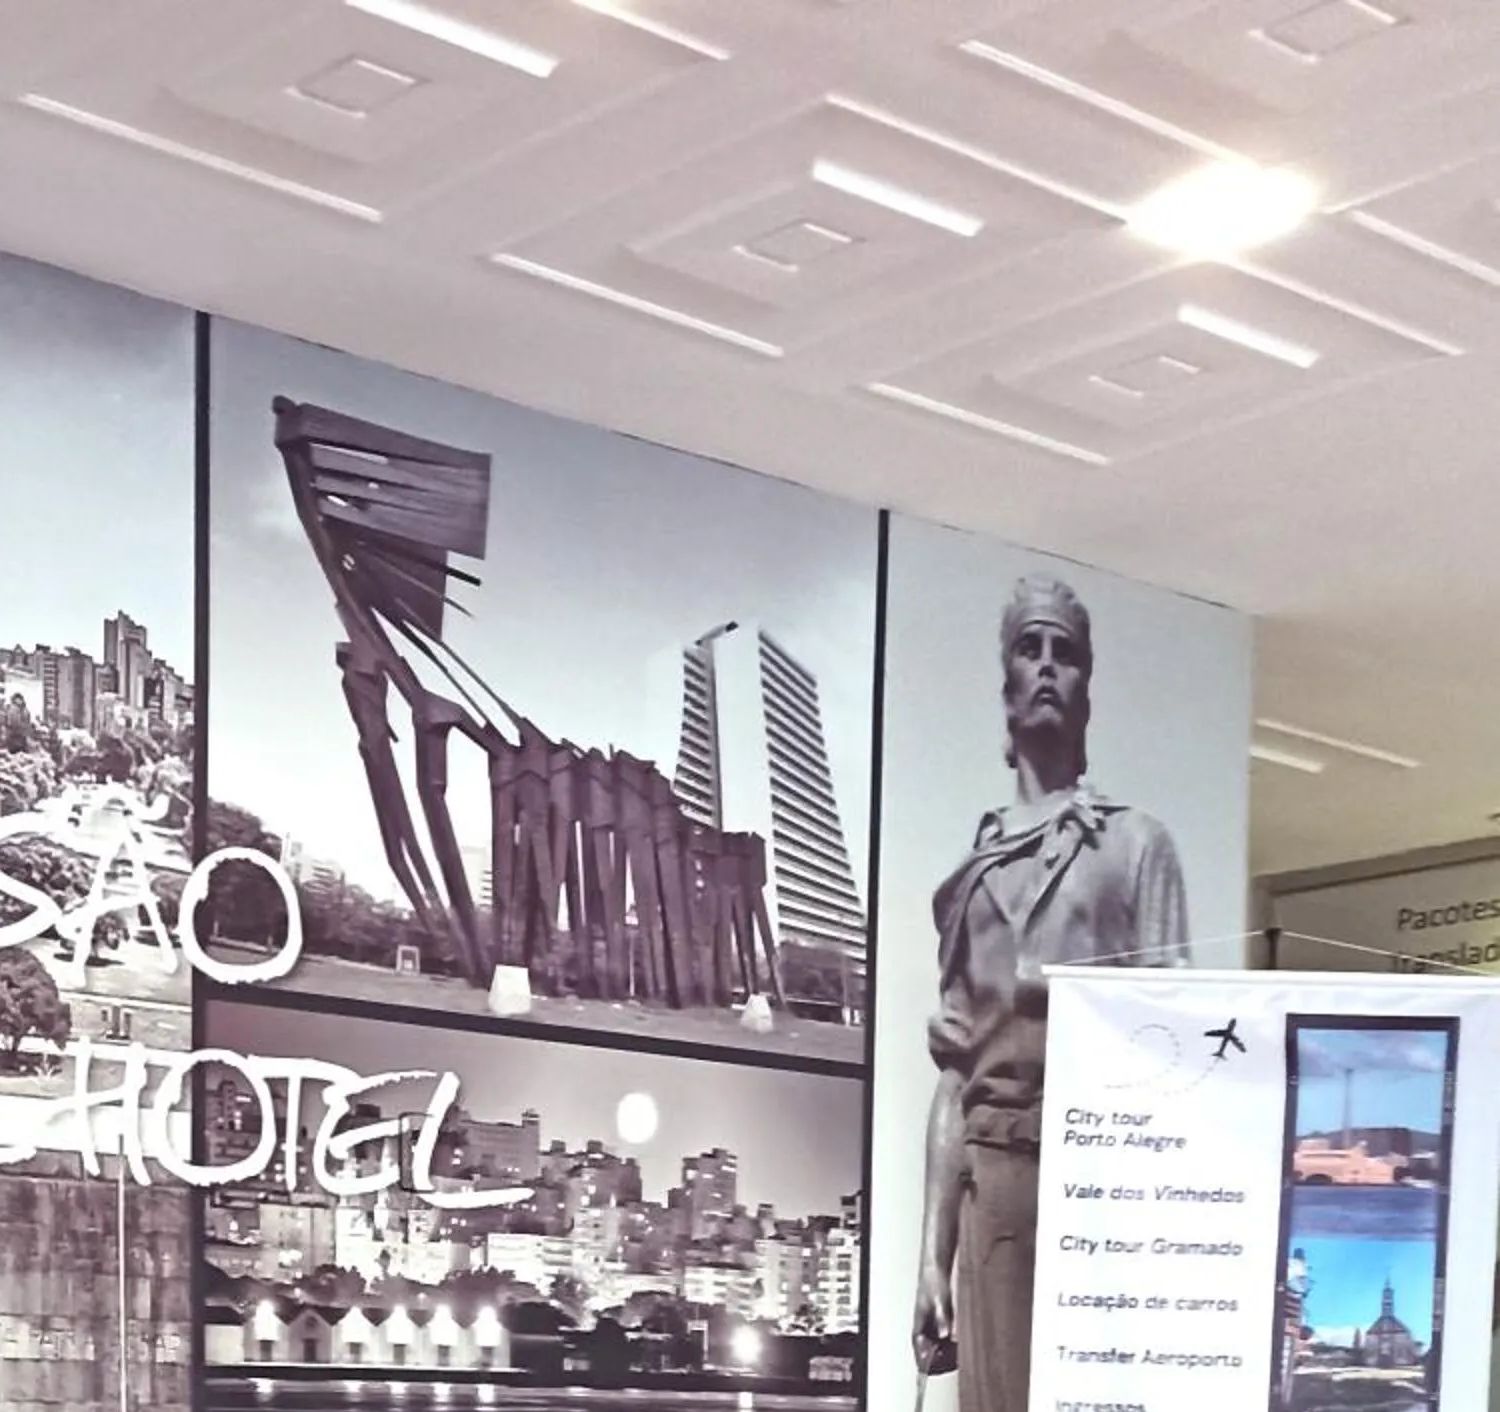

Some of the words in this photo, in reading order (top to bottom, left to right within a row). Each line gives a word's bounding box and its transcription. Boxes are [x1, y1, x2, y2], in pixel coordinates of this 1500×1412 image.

[1398, 898, 1500, 931] Pacotes
[50, 1036, 536, 1207] HOTEL
[1065, 1108, 1104, 1127] City
[1112, 1111, 1153, 1126] tour
[1064, 1129, 1117, 1147] Porto
[1123, 1132, 1187, 1152] Alegre
[1064, 1183, 1105, 1199] Vale
[1109, 1185, 1145, 1201] dos
[1154, 1185, 1246, 1203] Vinhedos
[1059, 1235, 1098, 1255] City
[1104, 1239, 1144, 1253] tour
[1150, 1238, 1244, 1256] Gramado
[1057, 1292, 1139, 1312] Locação
[1144, 1294, 1169, 1310] de
[1174, 1298, 1239, 1312] carros
[1056, 1345, 1135, 1364] Transfer
[1141, 1349, 1243, 1369] Aeroporto
